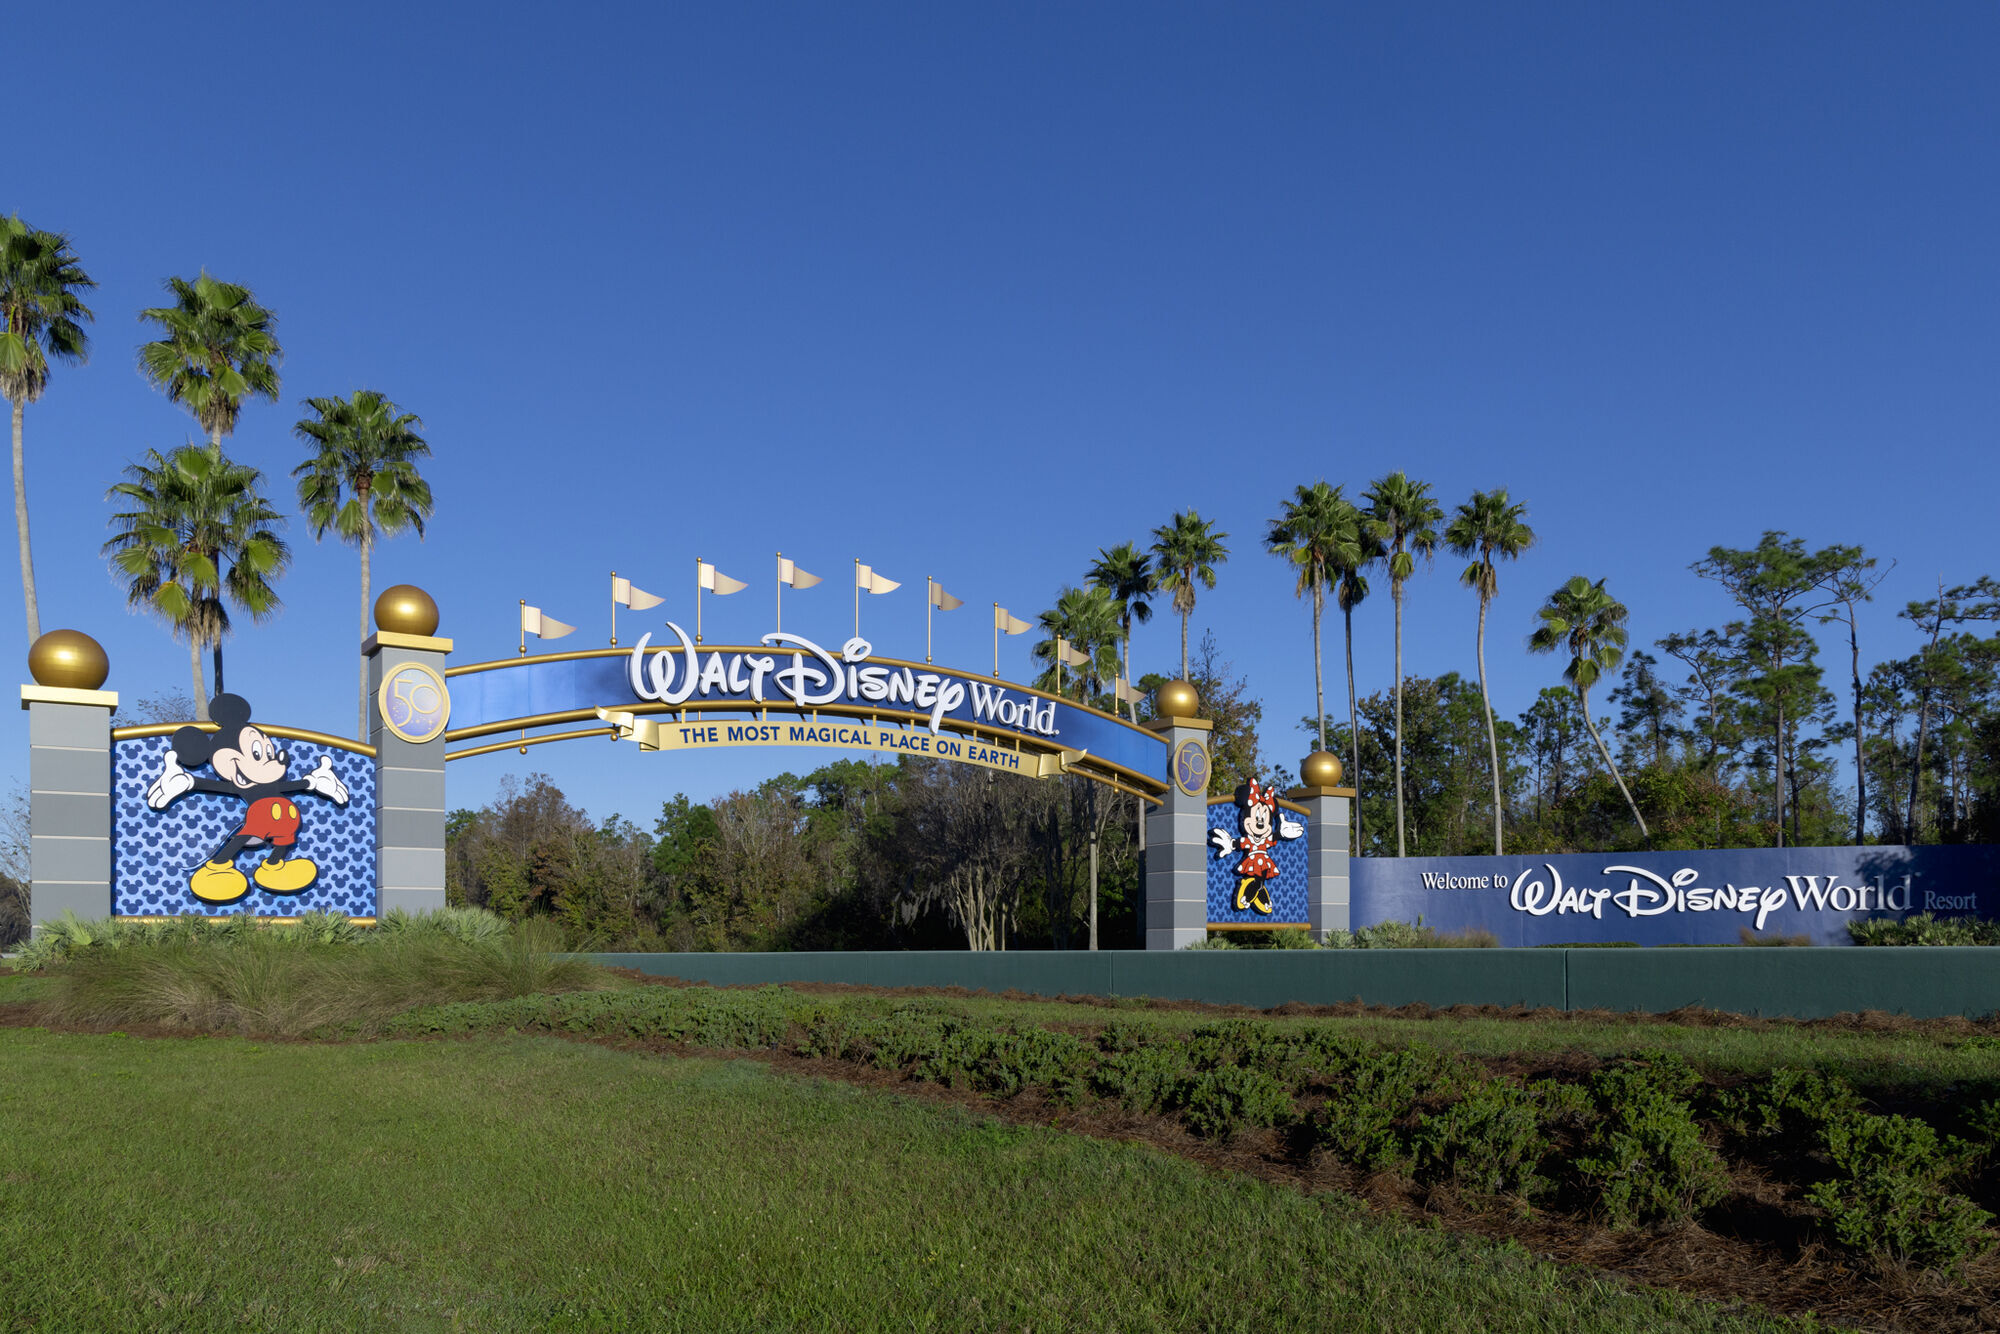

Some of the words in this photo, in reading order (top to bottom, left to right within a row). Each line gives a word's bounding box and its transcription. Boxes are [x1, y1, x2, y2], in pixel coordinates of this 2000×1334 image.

[394, 678, 442, 728] 50
[680, 727, 719, 744] THE
[728, 724, 781, 742] MOST
[789, 725, 872, 745] MAGICAL
[880, 732, 930, 752] PLACE
[936, 740, 961, 758] ON
[968, 746, 1020, 769] EARTH
[1182, 749, 1206, 785] 50
[1421, 872, 1489, 890] Welcome
[1491, 874, 1508, 889] to
[1785, 875, 1912, 911] World
[1924, 890, 1978, 910] Resort
